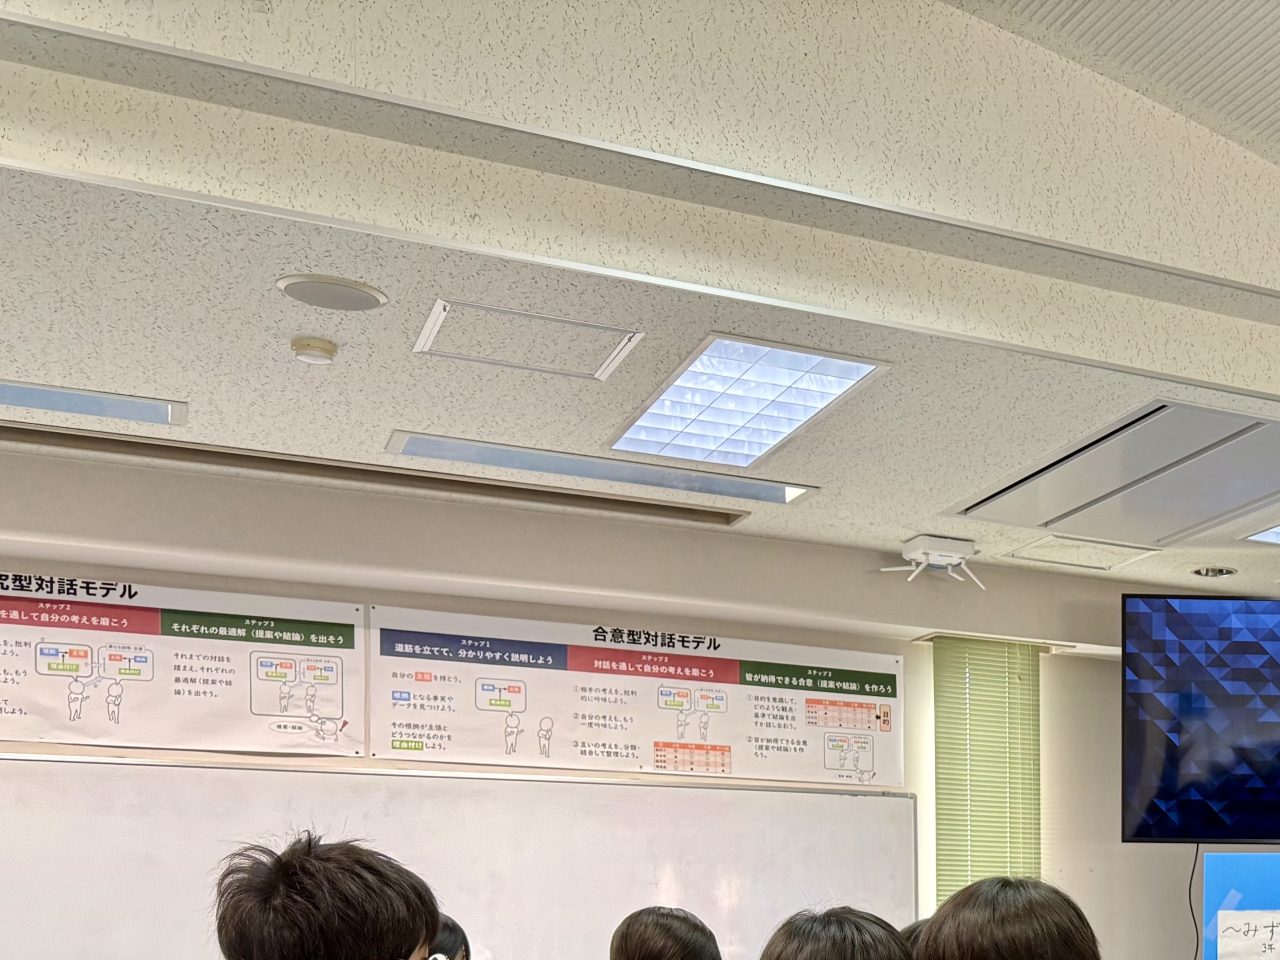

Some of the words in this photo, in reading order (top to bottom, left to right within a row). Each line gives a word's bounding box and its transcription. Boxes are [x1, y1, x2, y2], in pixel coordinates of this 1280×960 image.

[592, 626, 720, 651] 合意型対話モデル
